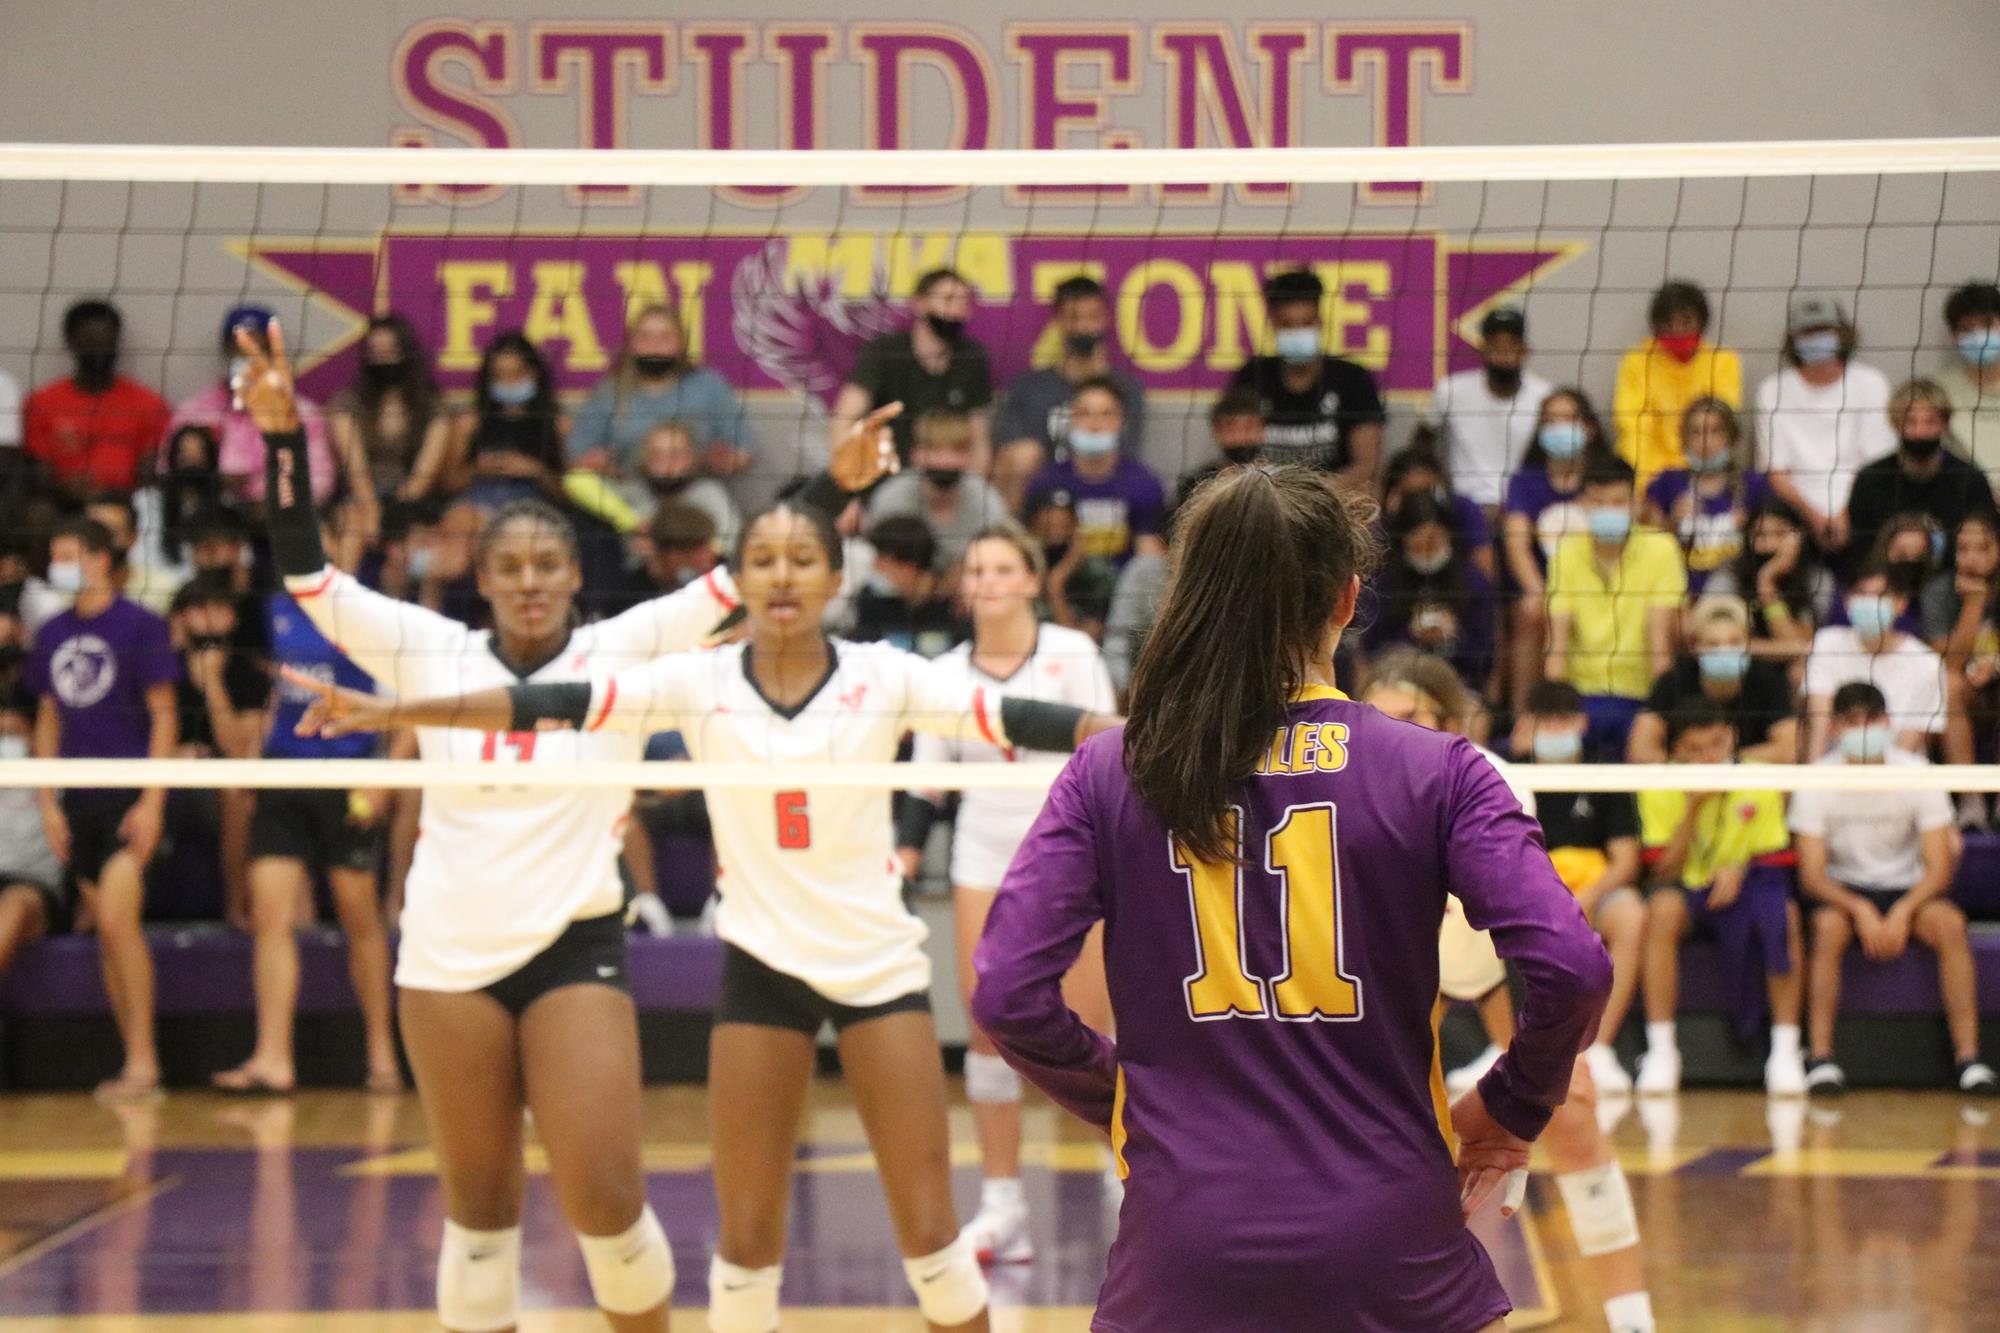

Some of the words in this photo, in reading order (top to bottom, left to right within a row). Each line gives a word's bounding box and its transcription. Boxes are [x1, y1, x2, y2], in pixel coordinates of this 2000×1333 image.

[393, 18, 1473, 206] STUDENT
[437, 259, 713, 371] FAN
[1030, 257, 1392, 372] ZONE
[774, 789, 811, 850] 6
[1167, 800, 1364, 1022] 11
